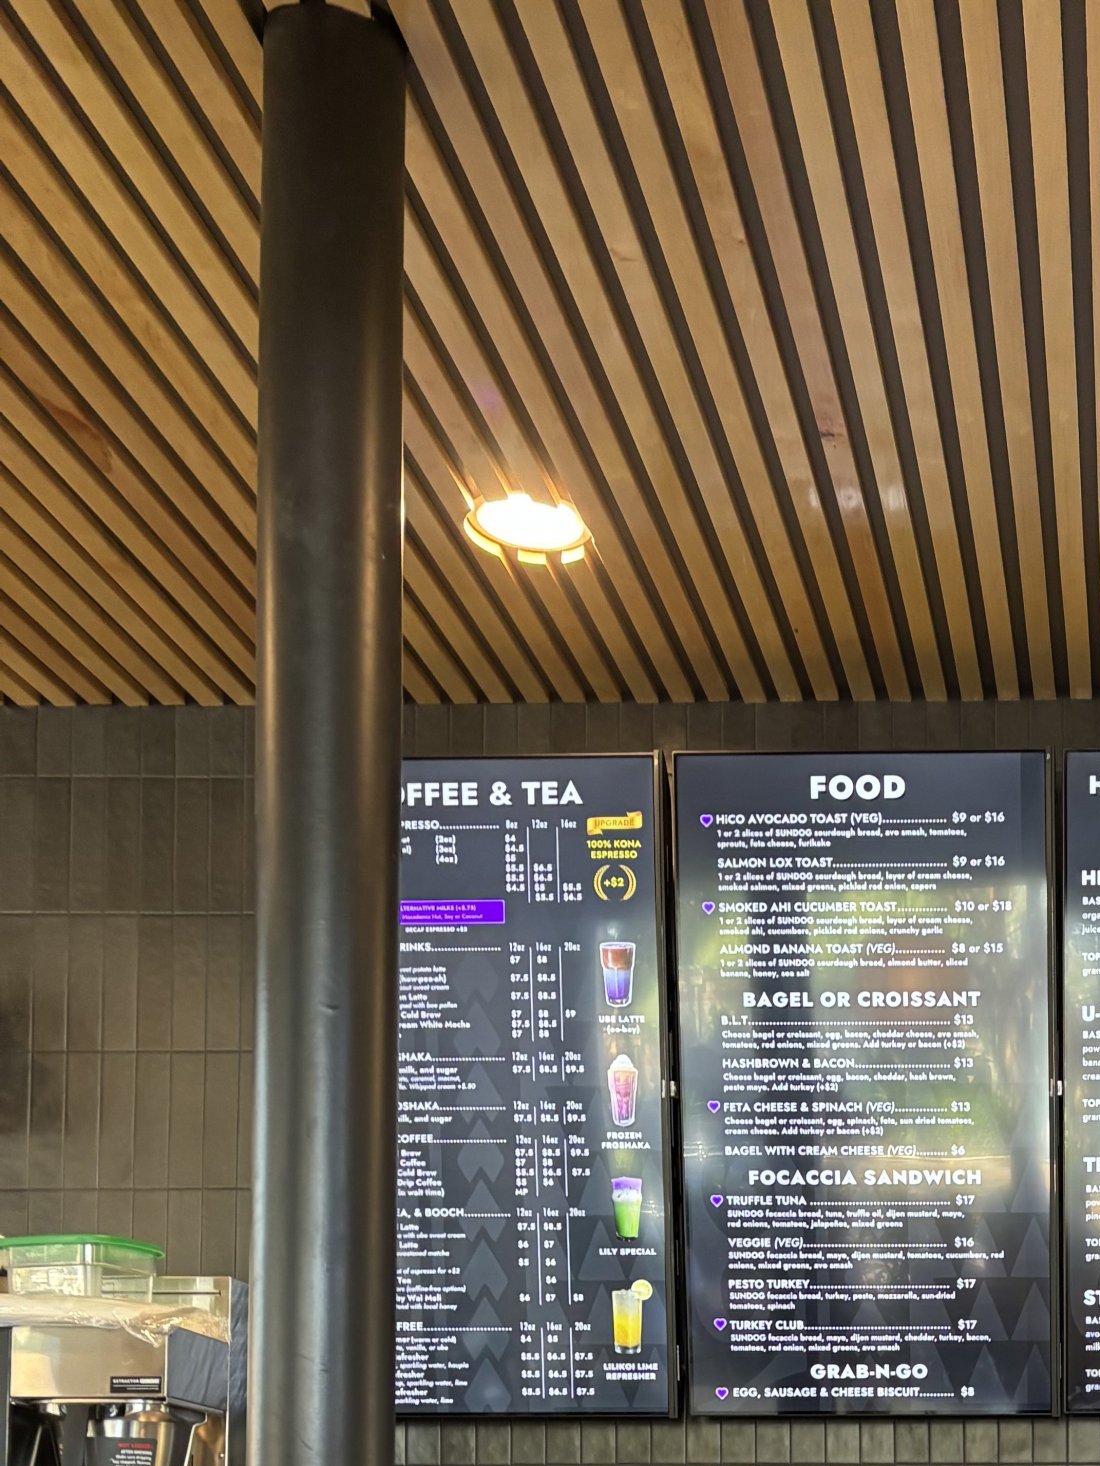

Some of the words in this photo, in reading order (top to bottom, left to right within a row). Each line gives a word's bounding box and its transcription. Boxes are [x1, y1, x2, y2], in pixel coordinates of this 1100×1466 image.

[810, 775, 906, 800] FOOD
[401, 782, 478, 806] FFEE
[489, 781, 512, 806] &
[521, 780, 583, 805] TEA
[748, 814, 807, 825] AVOCADO
[810, 814, 848, 825] TOAST
[850, 813, 882, 826] (VEG)
[952, 812, 966, 822] $9
[970, 814, 981, 823] or
[984, 811, 1005, 823] $16
[594, 818, 635, 827] UPGRADE
[587, 840, 611, 848] 100%
[613, 840, 641, 848] KONA
[591, 851, 637, 859] ESPRESSO
[718, 858, 766, 868] SALMON
[769, 858, 793, 868] LOX
[796, 858, 833, 868] TOAST
[604, 877, 624, 888] +$2
[719, 902, 767, 913] SMOKED
[770, 902, 791, 912] AHI
[794, 902, 857, 912] CUCUMBER
[860, 902, 897, 912] TOAST
[954, 901, 974, 911] $10
[978, 903, 989, 911] or
[992, 901, 1012, 911] $18
[509, 943, 525, 951] 12oz
[536, 943, 551, 951] 16oz
[564, 943, 580, 951] 20oz
[720, 944, 770, 954] ALMOND
[773, 944, 823, 954] BANANA
[826, 944, 863, 954] TOAST
[866, 943, 896, 955] (VEG)
[743, 992, 813, 1008] BAGEL
[820, 992, 850, 1008] OR
[857, 991, 980, 1008] CROISSANT
[401, 1011, 417, 1019] Cold
[420, 1011, 440, 1019] Brew
[599, 1015, 619, 1024] UBE
[622, 1015, 645, 1024] LATTE
[954, 1015, 973, 1025] $13
[723, 1058, 799, 1069] HASHBROWN
[802, 1058, 810, 1069] &
[814, 1058, 855, 1069] BACON
[724, 1103, 751, 1113] FETA
[754, 1103, 797, 1113] CHEESE
[801, 1103, 809, 1113] &
[812, 1103, 862, 1113] SPINACH
[866, 1102, 895, 1114] (VEG)
[951, 1102, 970, 1112] $13
[725, 1146, 762, 1157] BAGEL
[765, 1146, 795, 1157] WITH
[798, 1146, 838, 1157] CREAM
[841, 1146, 884, 1157] CHEESE
[887, 1145, 916, 1157] (VEG)
[951, 1145, 965, 1156] $6
[749, 1171, 856, 1185] FOCACCIA
[864, 1170, 982, 1185] SANDWICH
[727, 1196, 772, 1206] TRUFFLE
[775, 1196, 807, 1206] TUNA
[955, 1195, 975, 1205] $17
[424, 1208, 464, 1218] BOOCH
[728, 1238, 771, 1248] VEGGIE
[774, 1237, 803, 1249] (VEG)
[599, 1248, 617, 1256] LILY
[620, 1248, 657, 1256] SPECIAL
[728, 1279, 764, 1289] PESTO
[767, 1279, 810, 1289] TURKEY
[730, 1320, 773, 1330] TURKEY
[775, 1320, 804, 1330] CLUB
[638, 1363, 659, 1371] LIME
[810, 1364, 928, 1380] GRAB-N-GO
[606, 1372, 656, 1380] REFRESHER
[733, 1387, 760, 1399] EGG,
[764, 1387, 817, 1398] SAUSAGE
[820, 1387, 828, 1398] &
[831, 1387, 874, 1398] CHEESE
[877, 1387, 920, 1398] BISCUIT
[961, 1387, 974, 1398] $8
